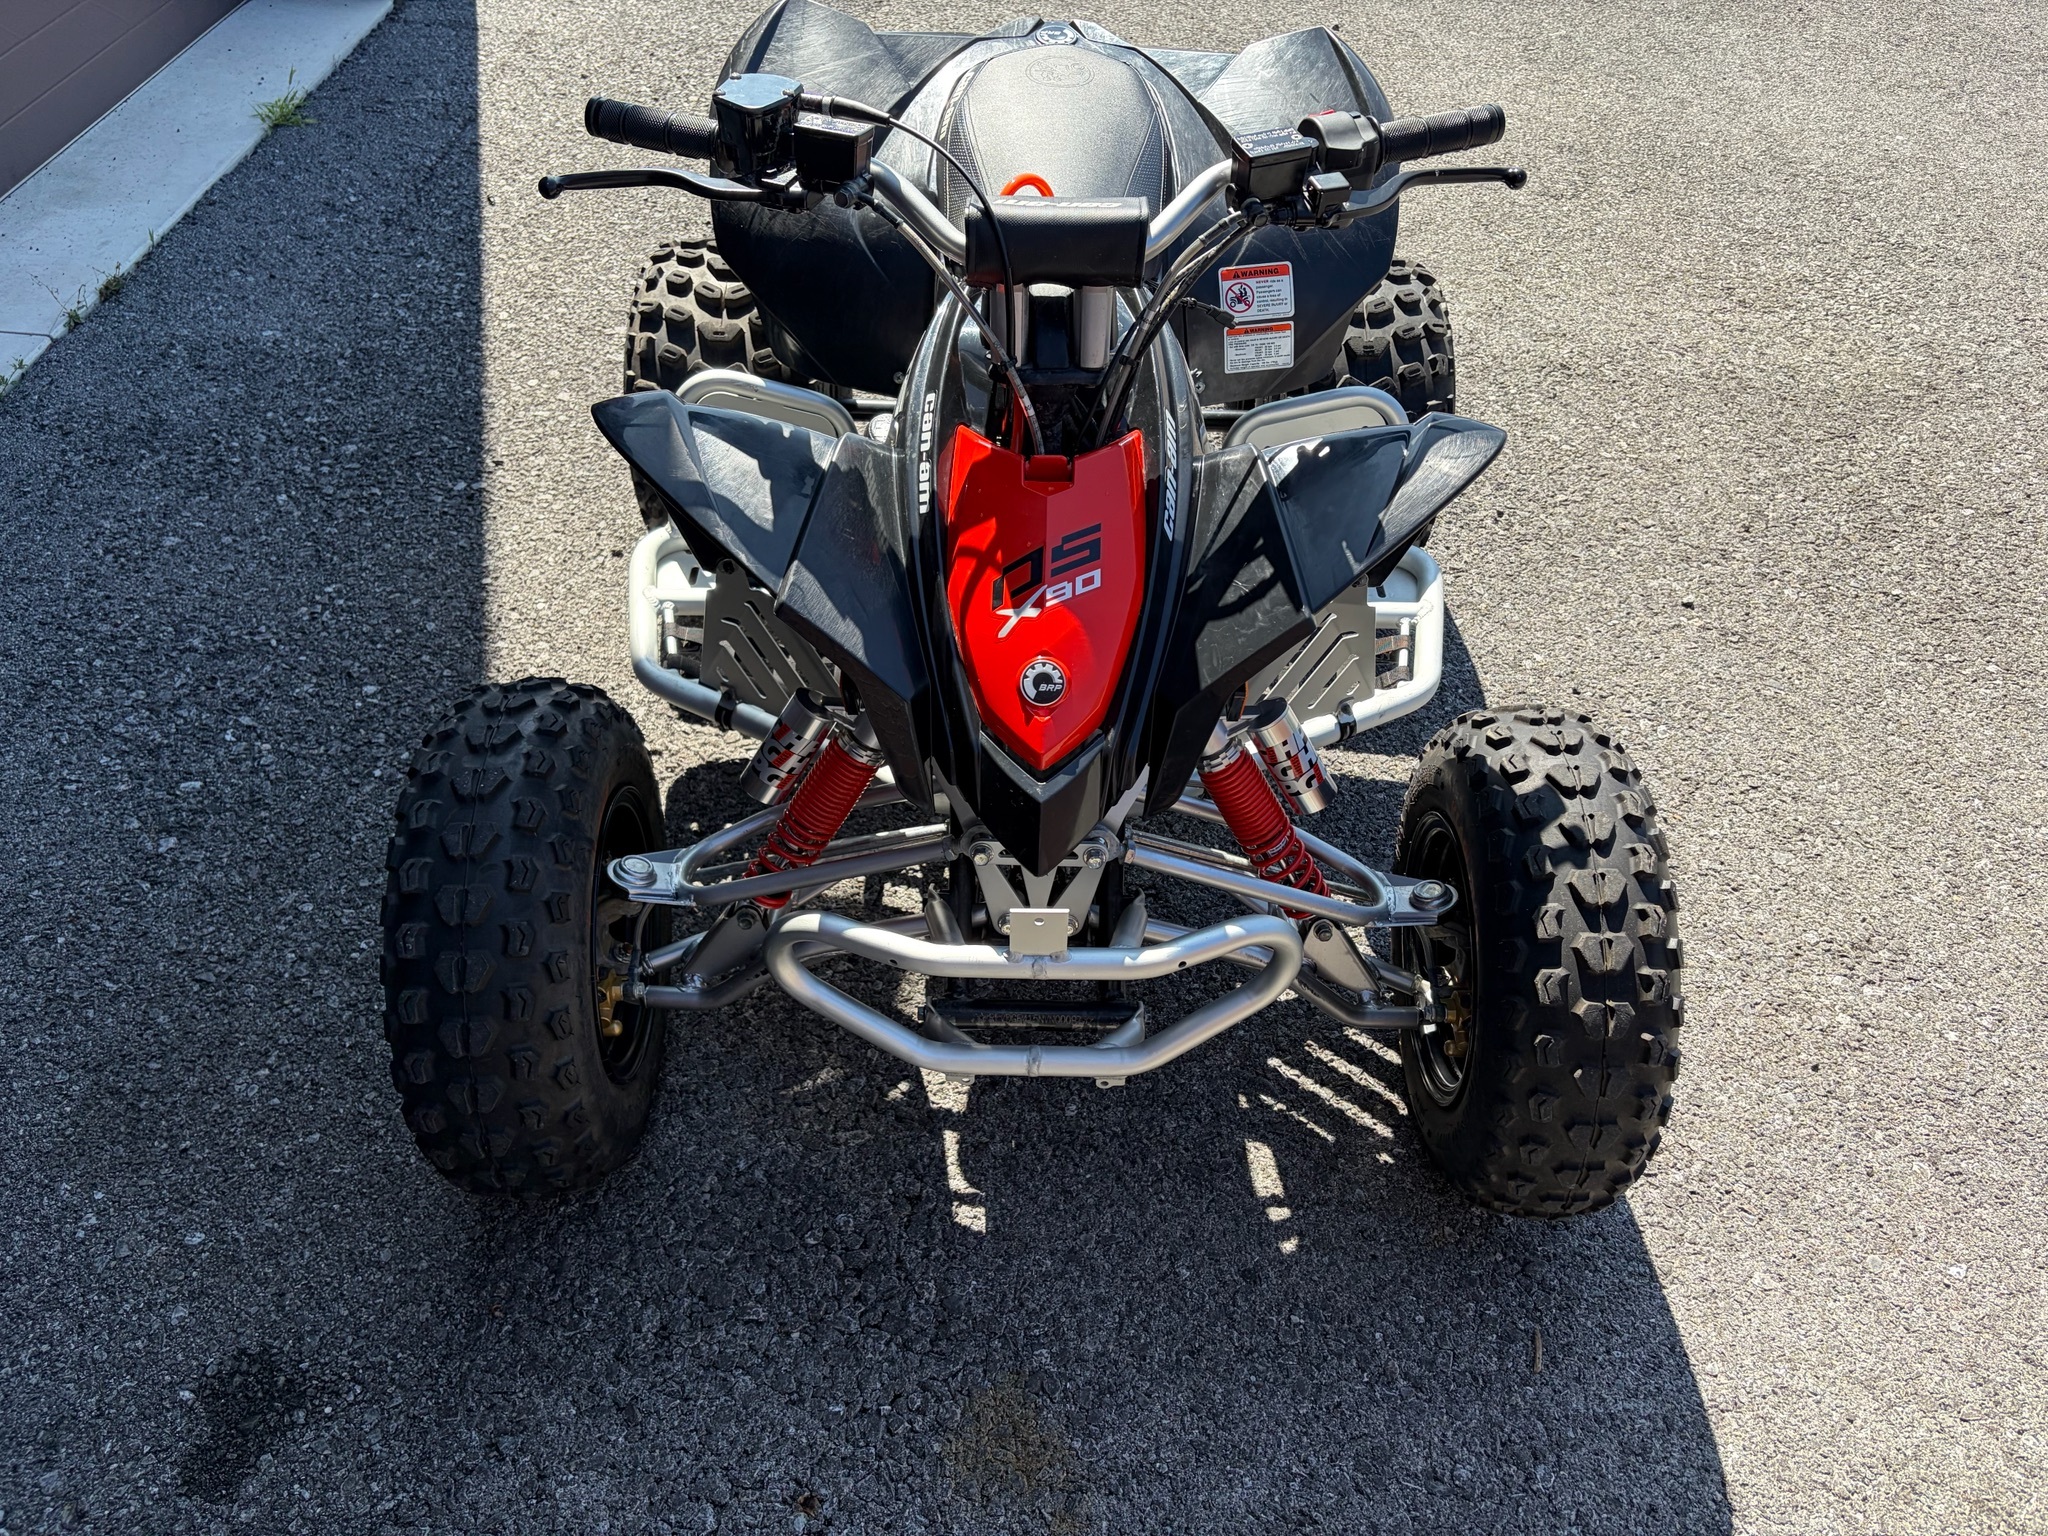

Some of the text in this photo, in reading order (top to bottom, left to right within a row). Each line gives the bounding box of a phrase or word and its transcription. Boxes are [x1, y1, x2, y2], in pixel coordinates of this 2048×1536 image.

[1240, 267, 1280, 277] WARNING
[918, 392, 936, 514] can-am
[1163, 409, 1178, 542] can-am
[995, 568, 1102, 639] X90
[1038, 683, 1063, 692] BRP
